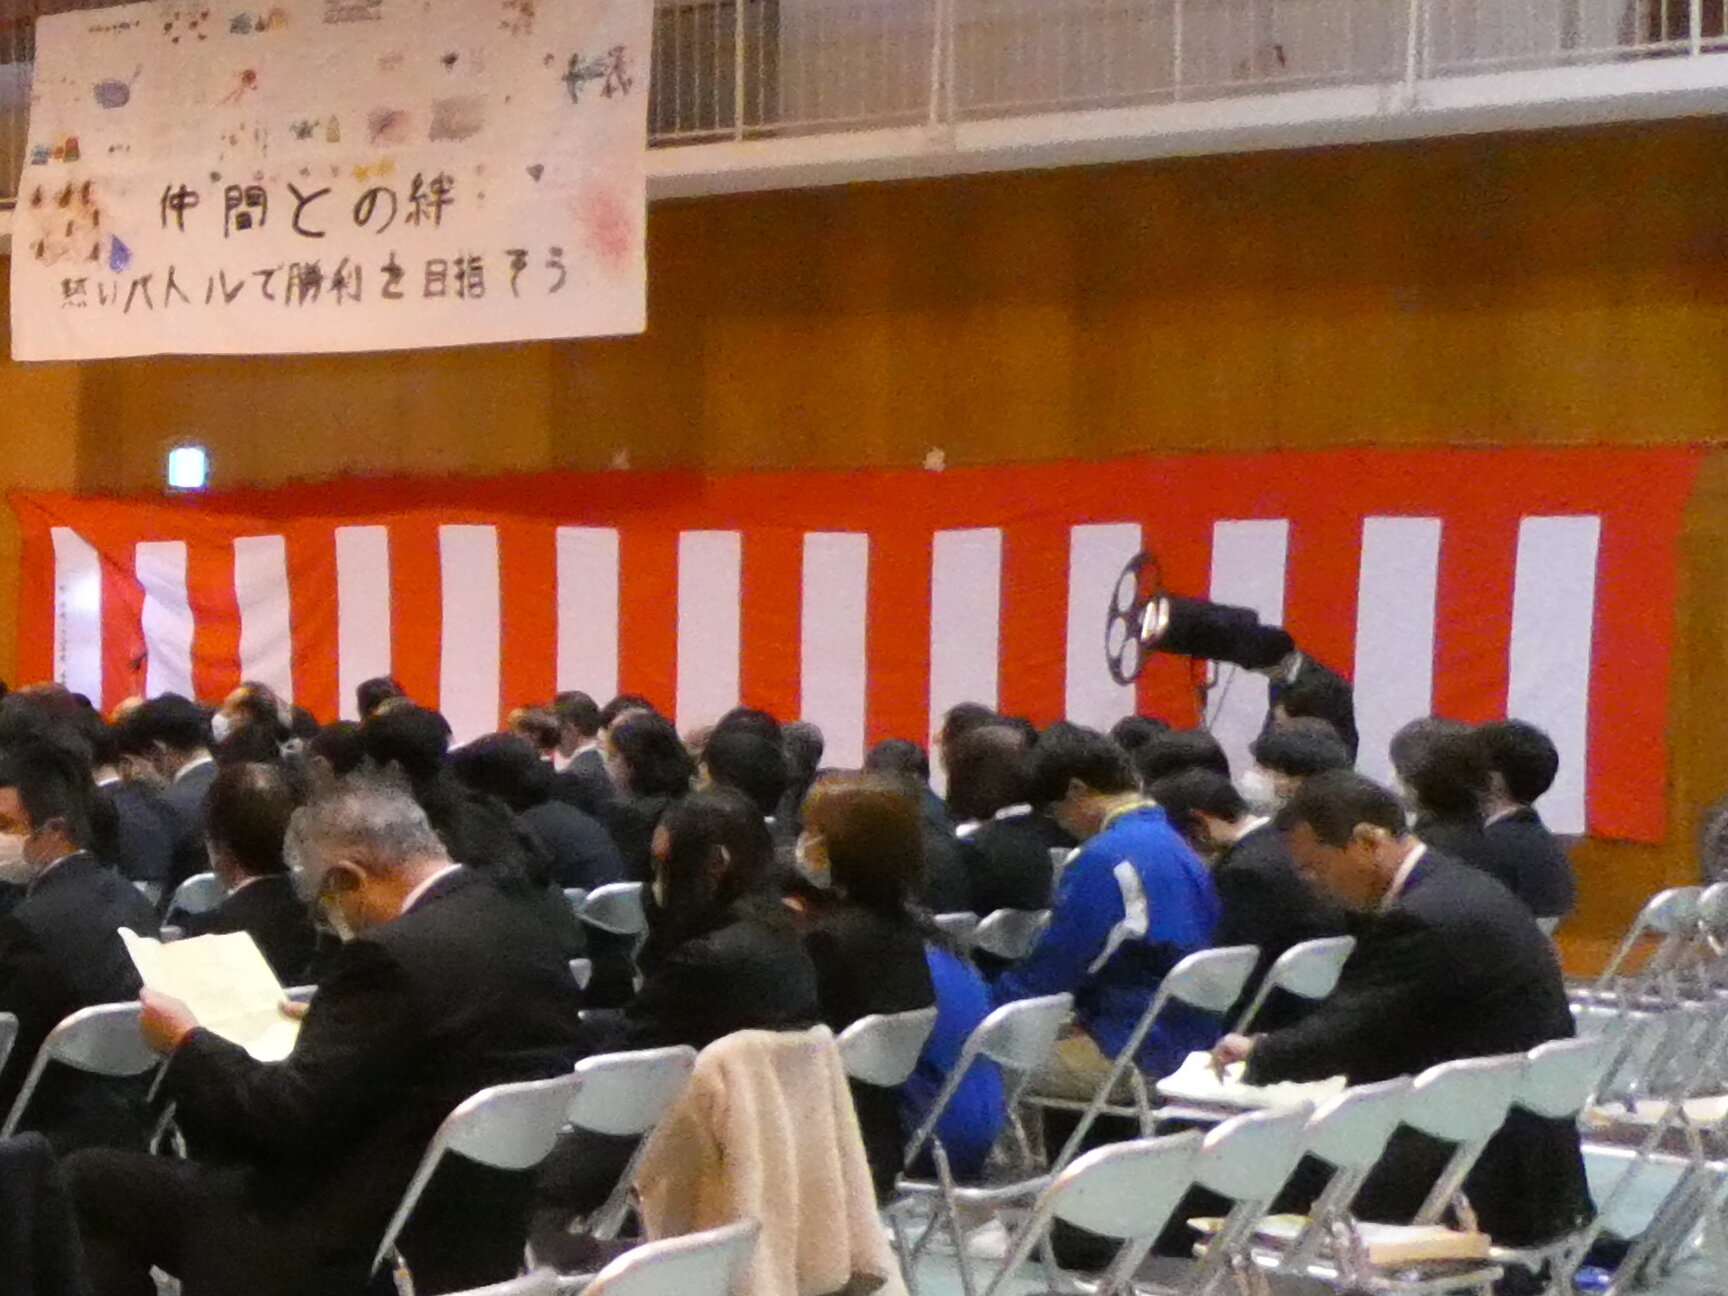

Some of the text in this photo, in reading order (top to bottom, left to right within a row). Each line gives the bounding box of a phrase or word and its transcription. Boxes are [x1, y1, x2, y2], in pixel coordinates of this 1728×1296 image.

[160, 172, 454, 238] 仲間との絆
